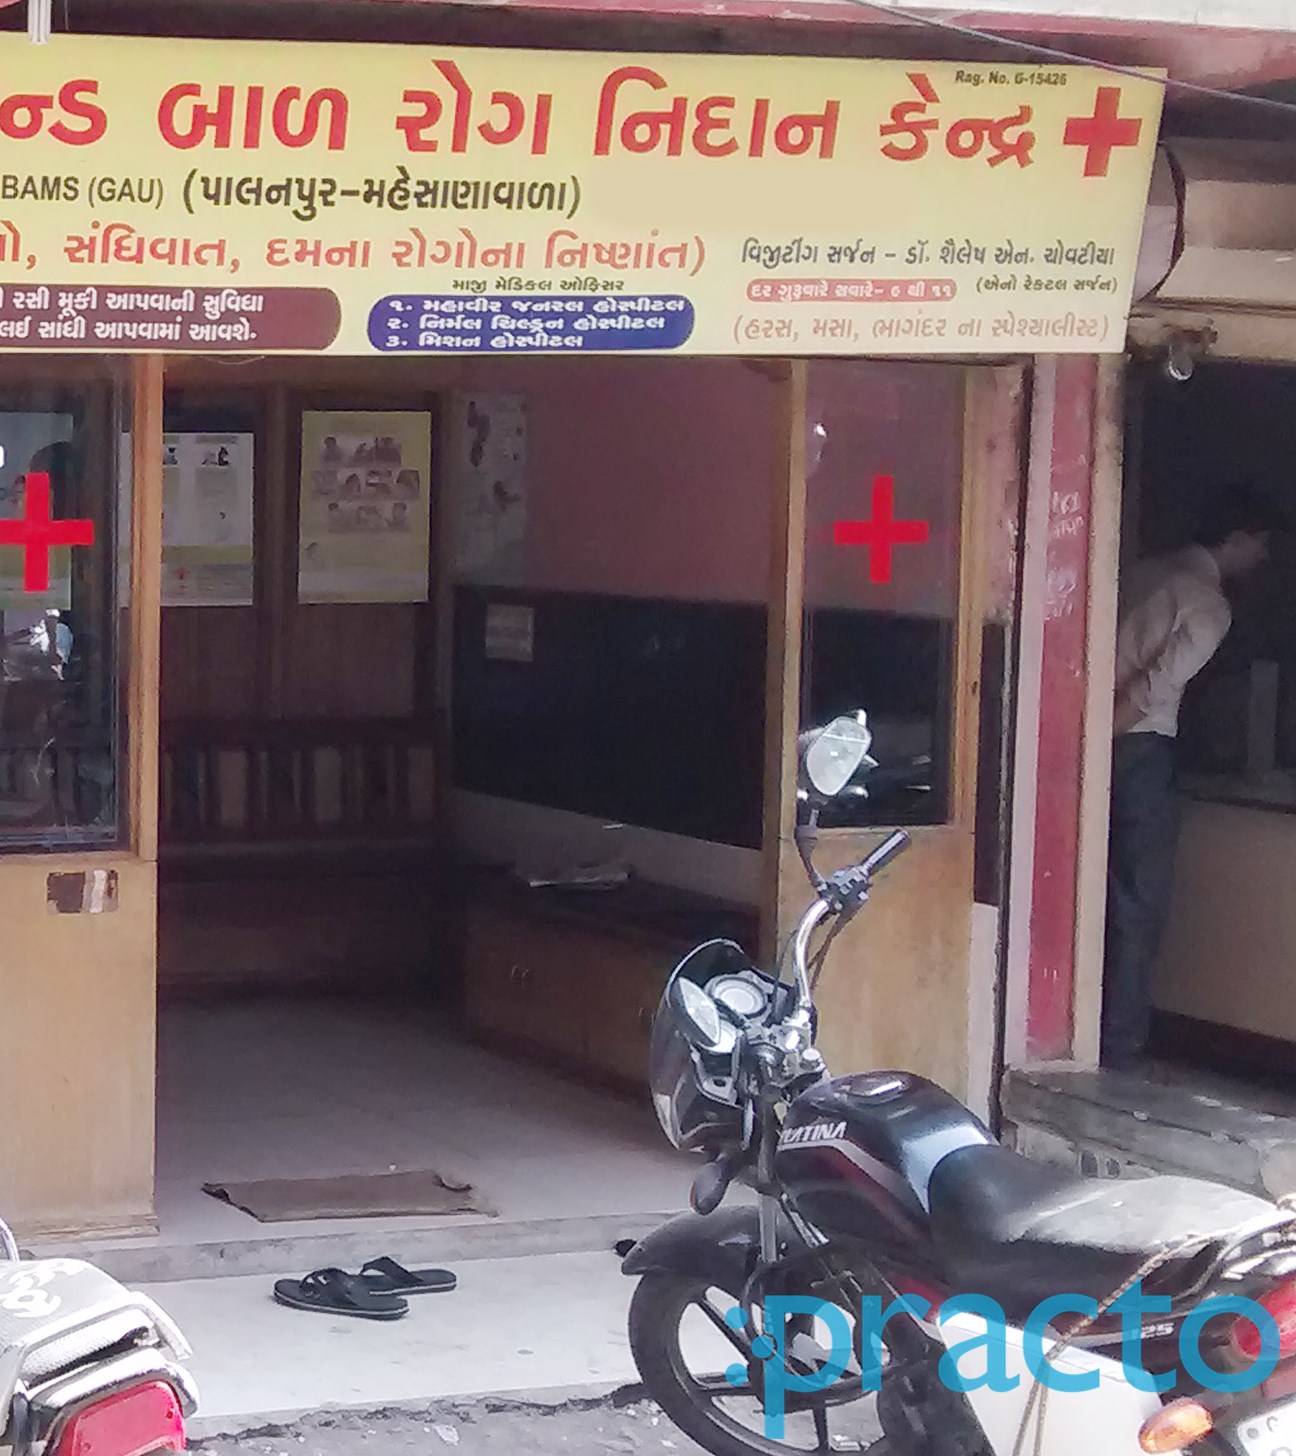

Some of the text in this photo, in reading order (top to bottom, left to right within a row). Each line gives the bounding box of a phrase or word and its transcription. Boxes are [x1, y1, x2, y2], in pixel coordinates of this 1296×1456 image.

[989, 71, 1010, 85] No.
[157, 83, 349, 152] બાળ
[395, 59, 553, 155] રોગ
[594, 65, 840, 160] નિદાન
[879, 72, 1036, 168] કેન્દ્ર
[1, 173, 80, 202] BAMS
[87, 175, 165, 209] (GAU)
[63, 220, 241, 273] સંધિવાત,
[266, 236, 371, 269] દમના
[391, 228, 528, 269] રોગોના
[545, 228, 706, 277] નિષ્ણાંત)
[827, 239, 875, 264] સર્જન
[940, 238, 986, 265] શૈલેષ
[994, 239, 1035, 265] એન.
[494, 276, 552, 292] મેડિકલ
[751, 283, 772, 298] દર
[906, 280, 925, 298] થી
[13, 287, 50, 310] રસી
[106, 289, 195, 313] આપવાની
[203, 289, 264, 320] સુવિધા
[423, 298, 502, 313] મહાવીર
[511, 299, 584, 313] જનરલ
[593, 297, 685, 313] હોસ્પીટલ
[38, 312, 86, 339] સાંધી
[94, 316, 182, 341] આપવામાં
[188, 317, 257, 341] આવશે.
[573, 314, 665, 331] હોસ્પીટલ
[957, 318, 982, 338] ના
[490, 331, 584, 348] હોસ્પીટલ
